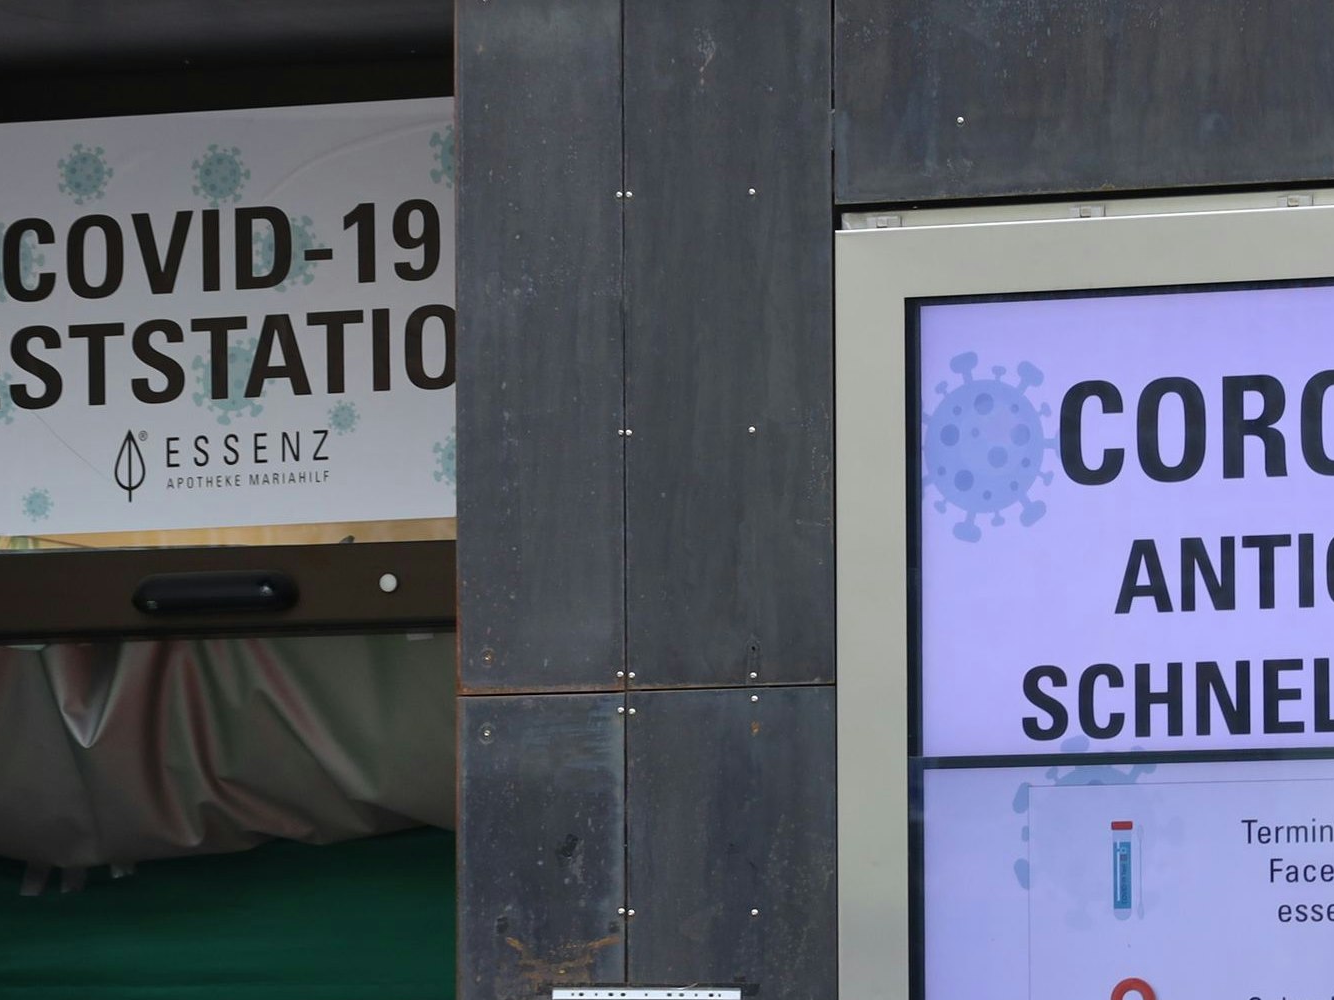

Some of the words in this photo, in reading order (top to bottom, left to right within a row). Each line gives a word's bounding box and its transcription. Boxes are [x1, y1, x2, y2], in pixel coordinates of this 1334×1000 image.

[2, 198, 441, 303] COVID-19
[166, 429, 329, 468] ESSENZ
[166, 474, 241, 490] APOTHEKE
[249, 470, 330, 486] MARIAHILF
